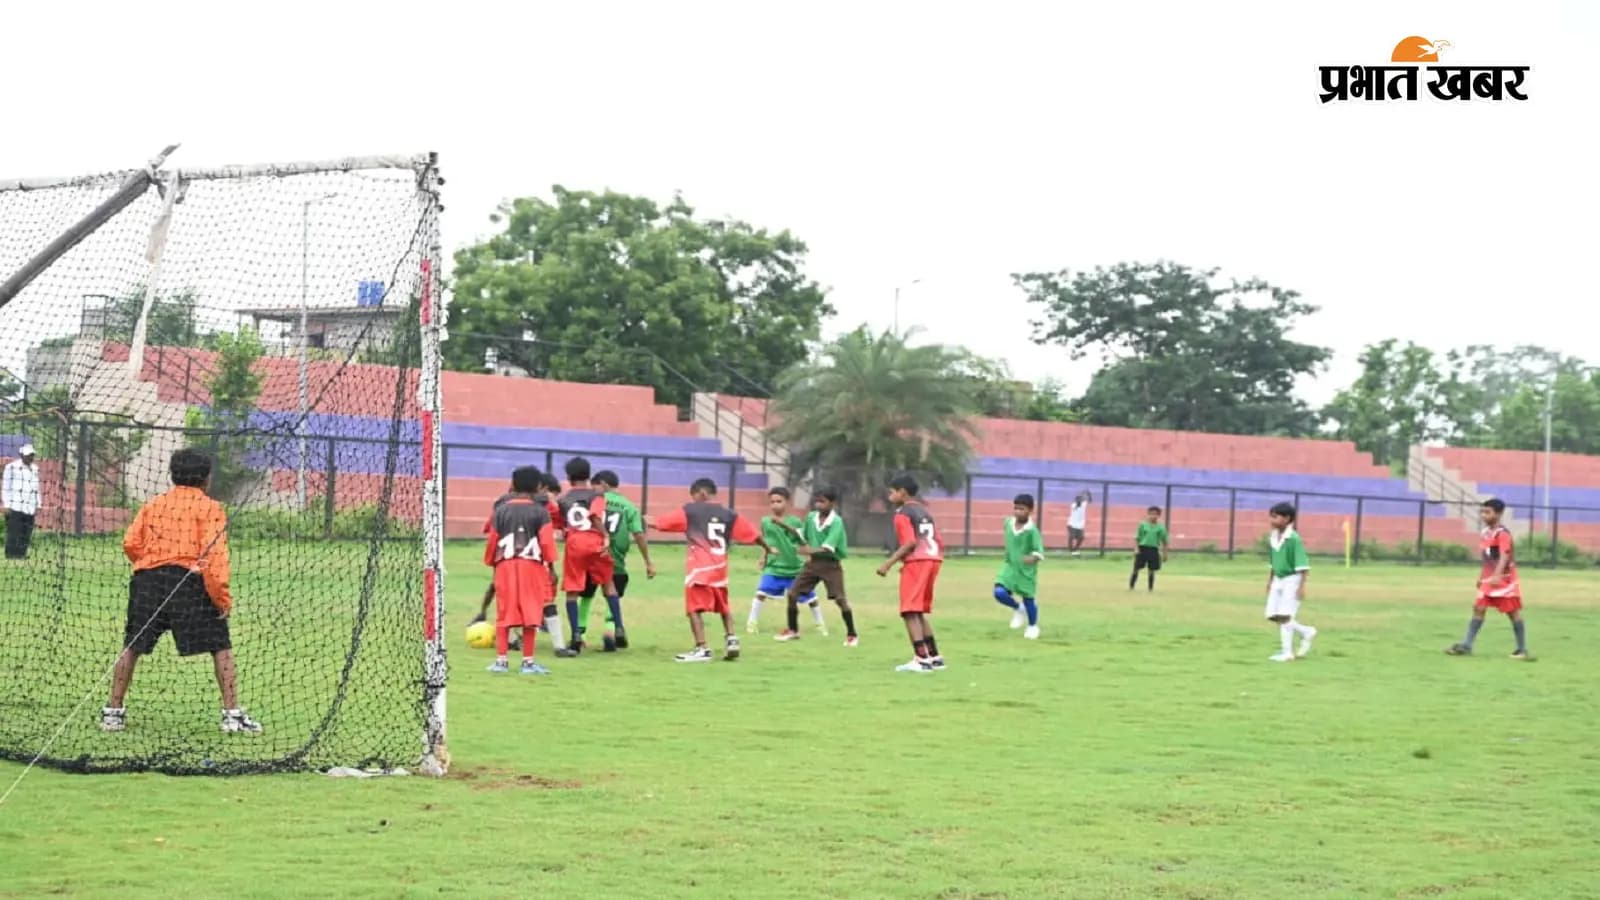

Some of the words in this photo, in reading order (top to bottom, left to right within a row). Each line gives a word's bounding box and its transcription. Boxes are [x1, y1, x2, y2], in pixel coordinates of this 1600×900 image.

[567, 506, 592, 531] 9
[497, 532, 542, 561] 14
[707, 522, 726, 556] 5
[918, 522, 939, 557] 3
